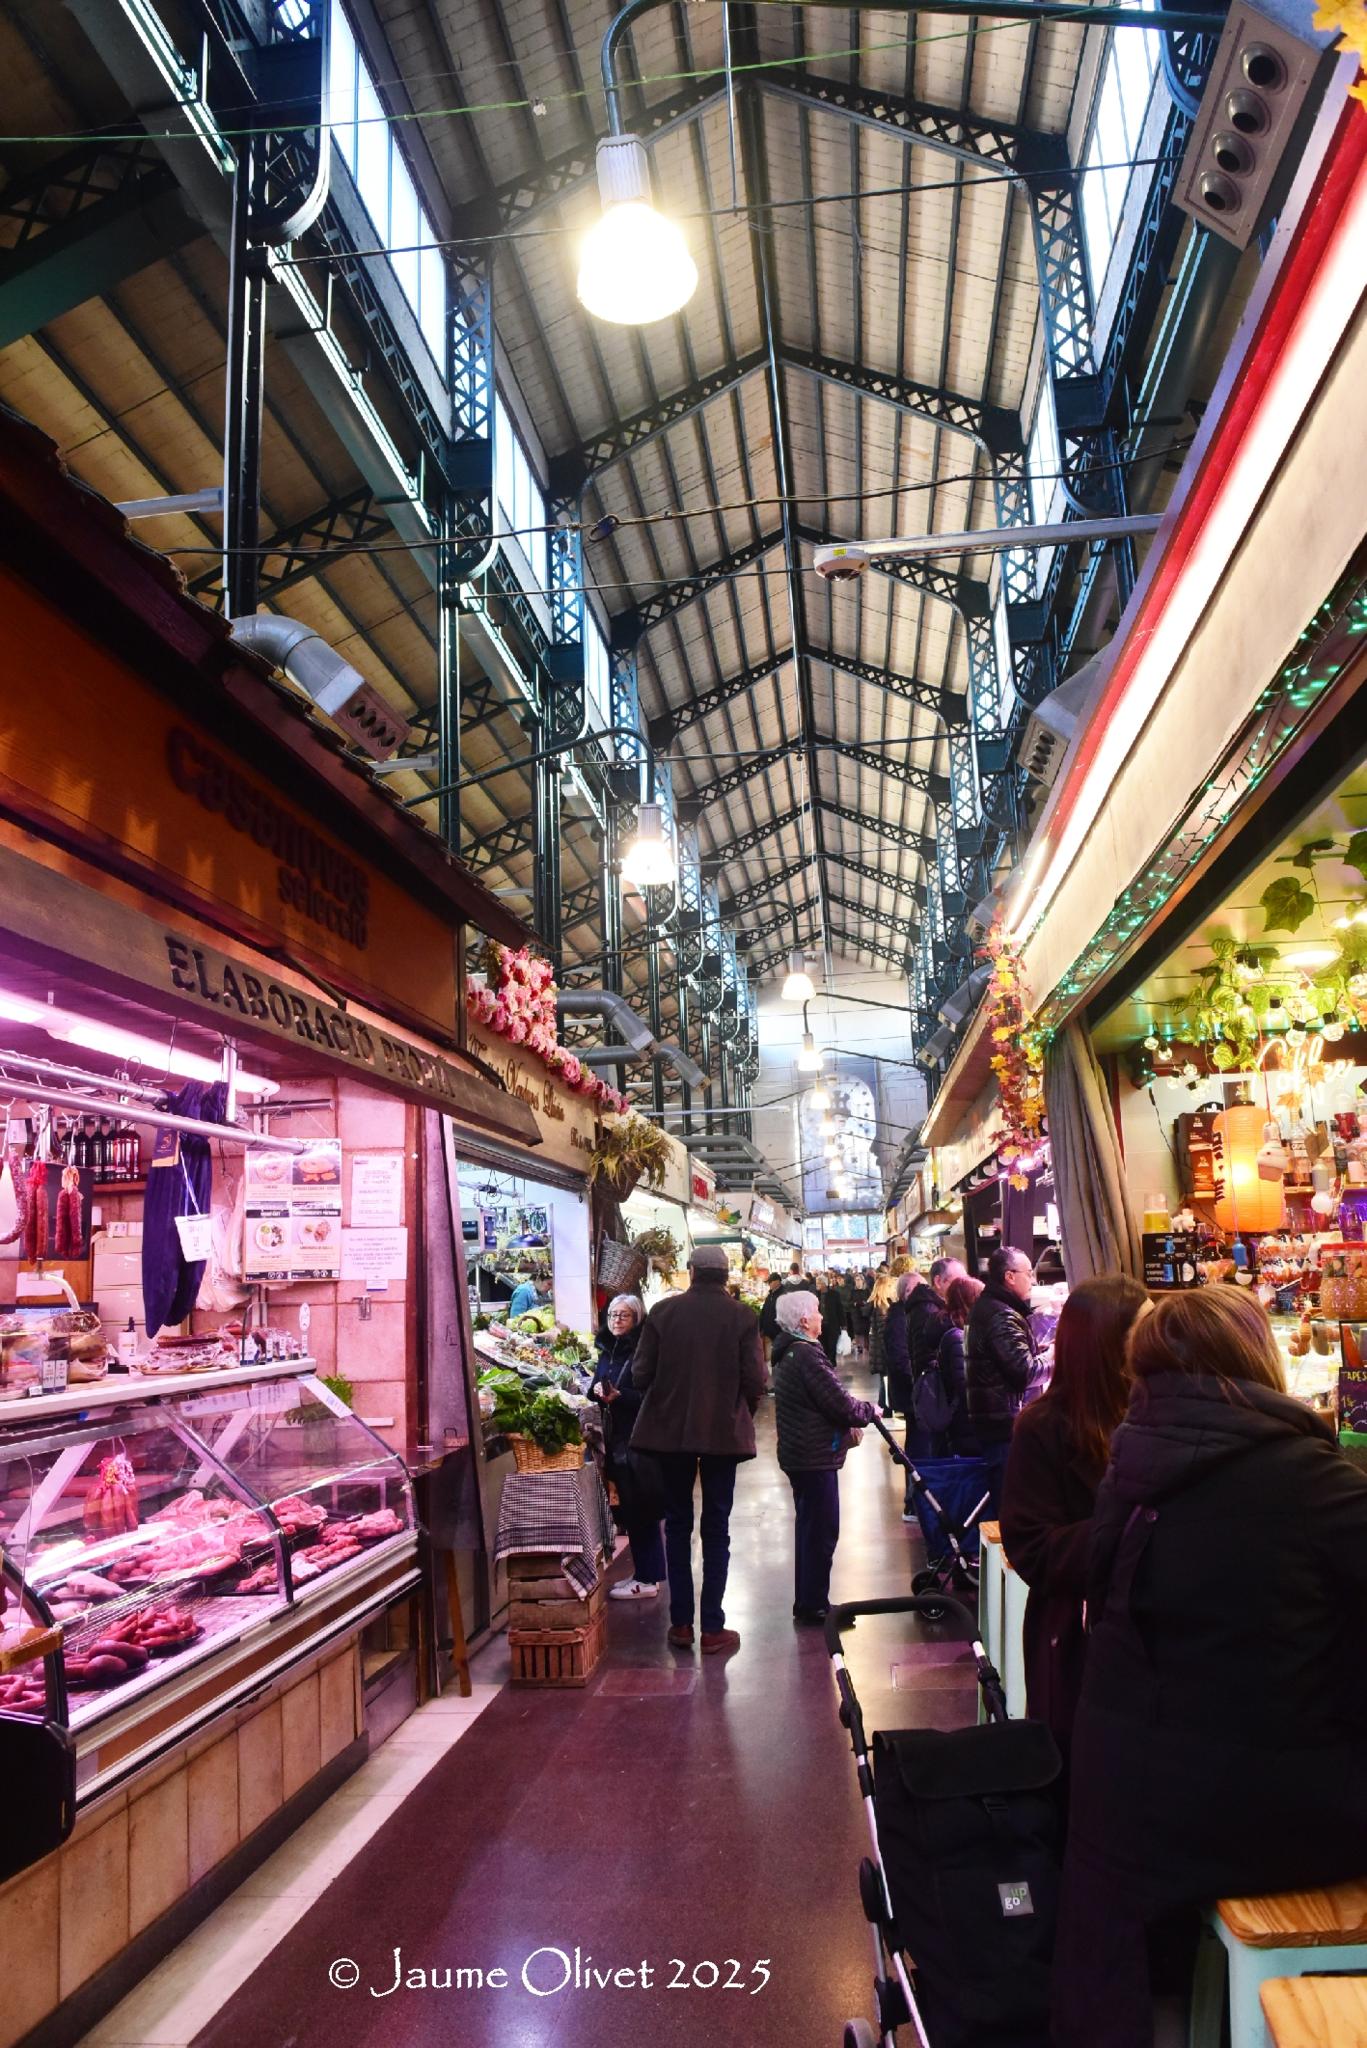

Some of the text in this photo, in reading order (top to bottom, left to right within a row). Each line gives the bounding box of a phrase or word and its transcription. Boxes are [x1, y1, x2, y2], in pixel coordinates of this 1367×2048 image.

[164, 936, 376, 1067] ELABORACIÓ
[1010, 1887, 1027, 1901] up
[1004, 1896, 1021, 1910] go
